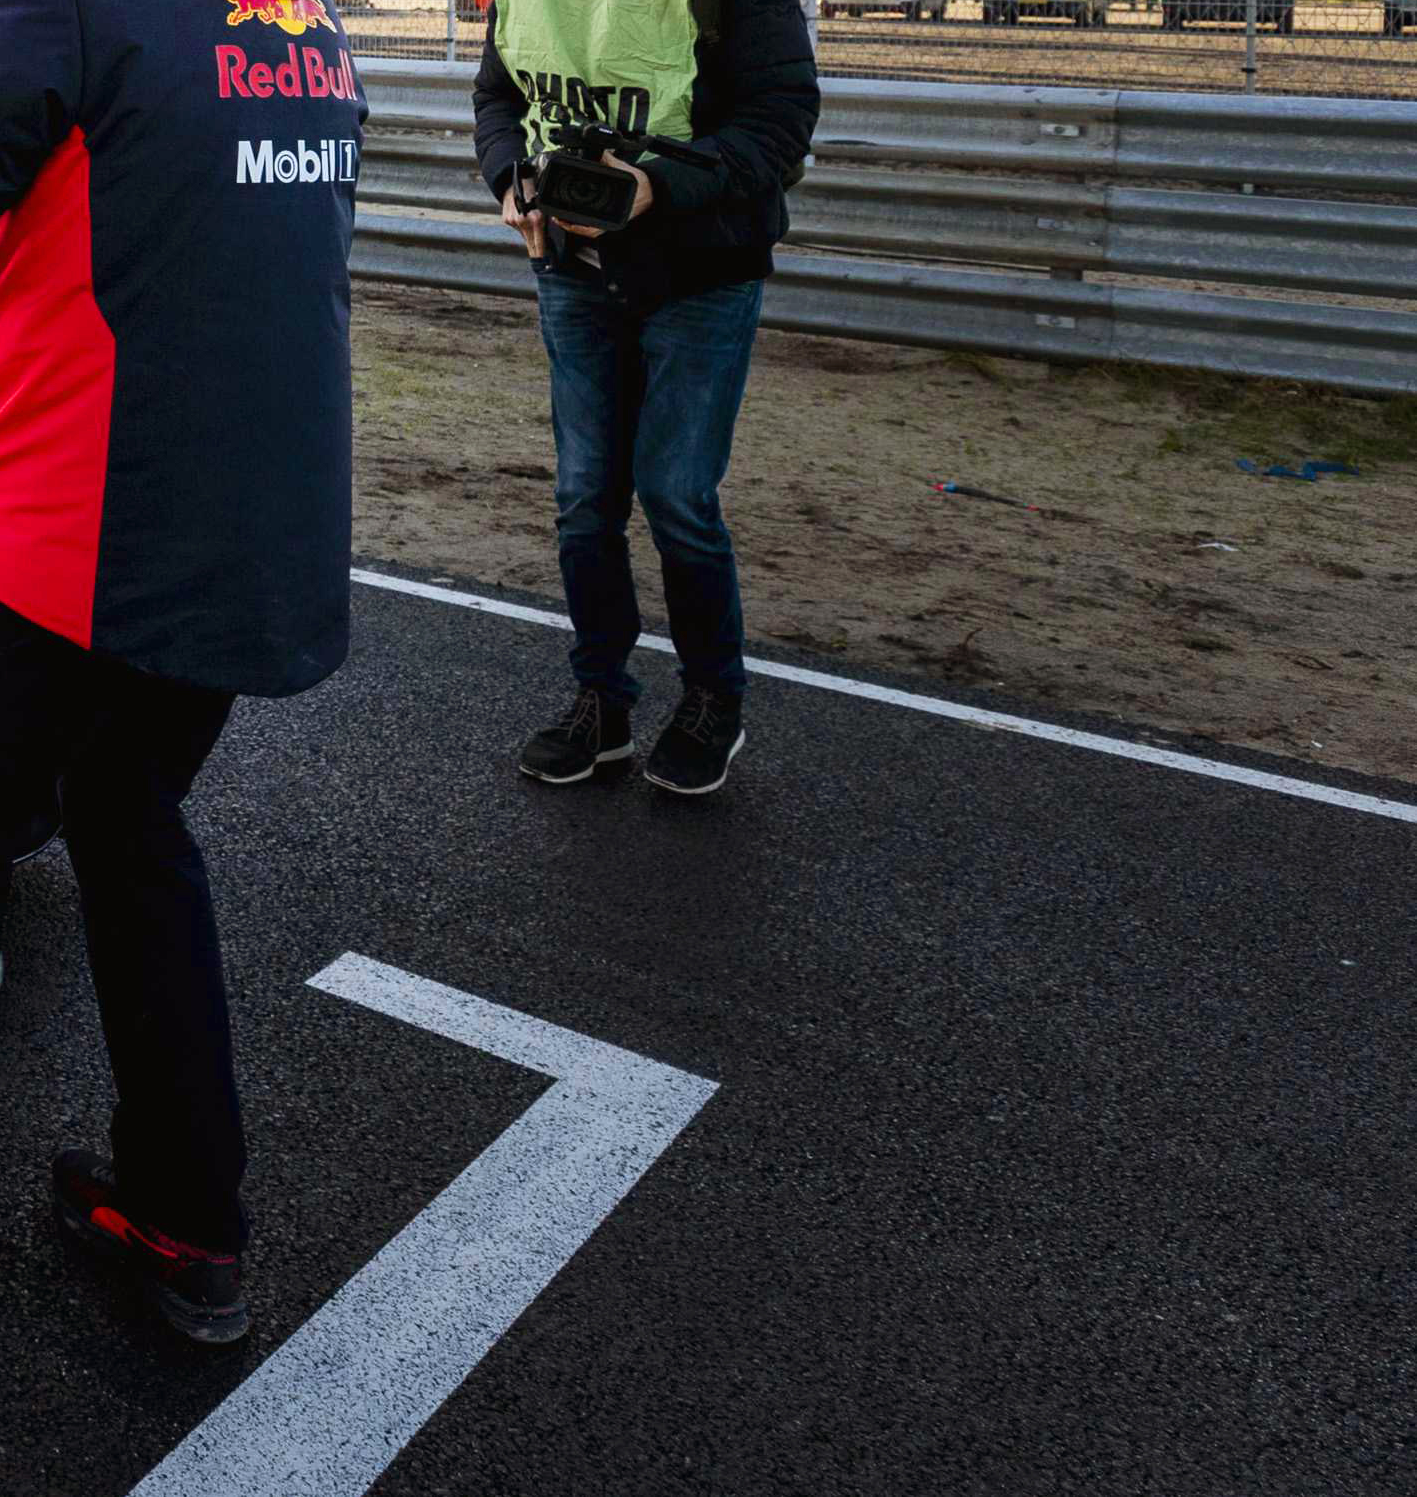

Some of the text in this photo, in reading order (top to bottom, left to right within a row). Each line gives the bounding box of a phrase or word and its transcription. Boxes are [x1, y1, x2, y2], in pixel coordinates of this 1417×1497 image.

[215, 43, 358, 101] Red Bull
[236, 140, 335, 184] Mobil
